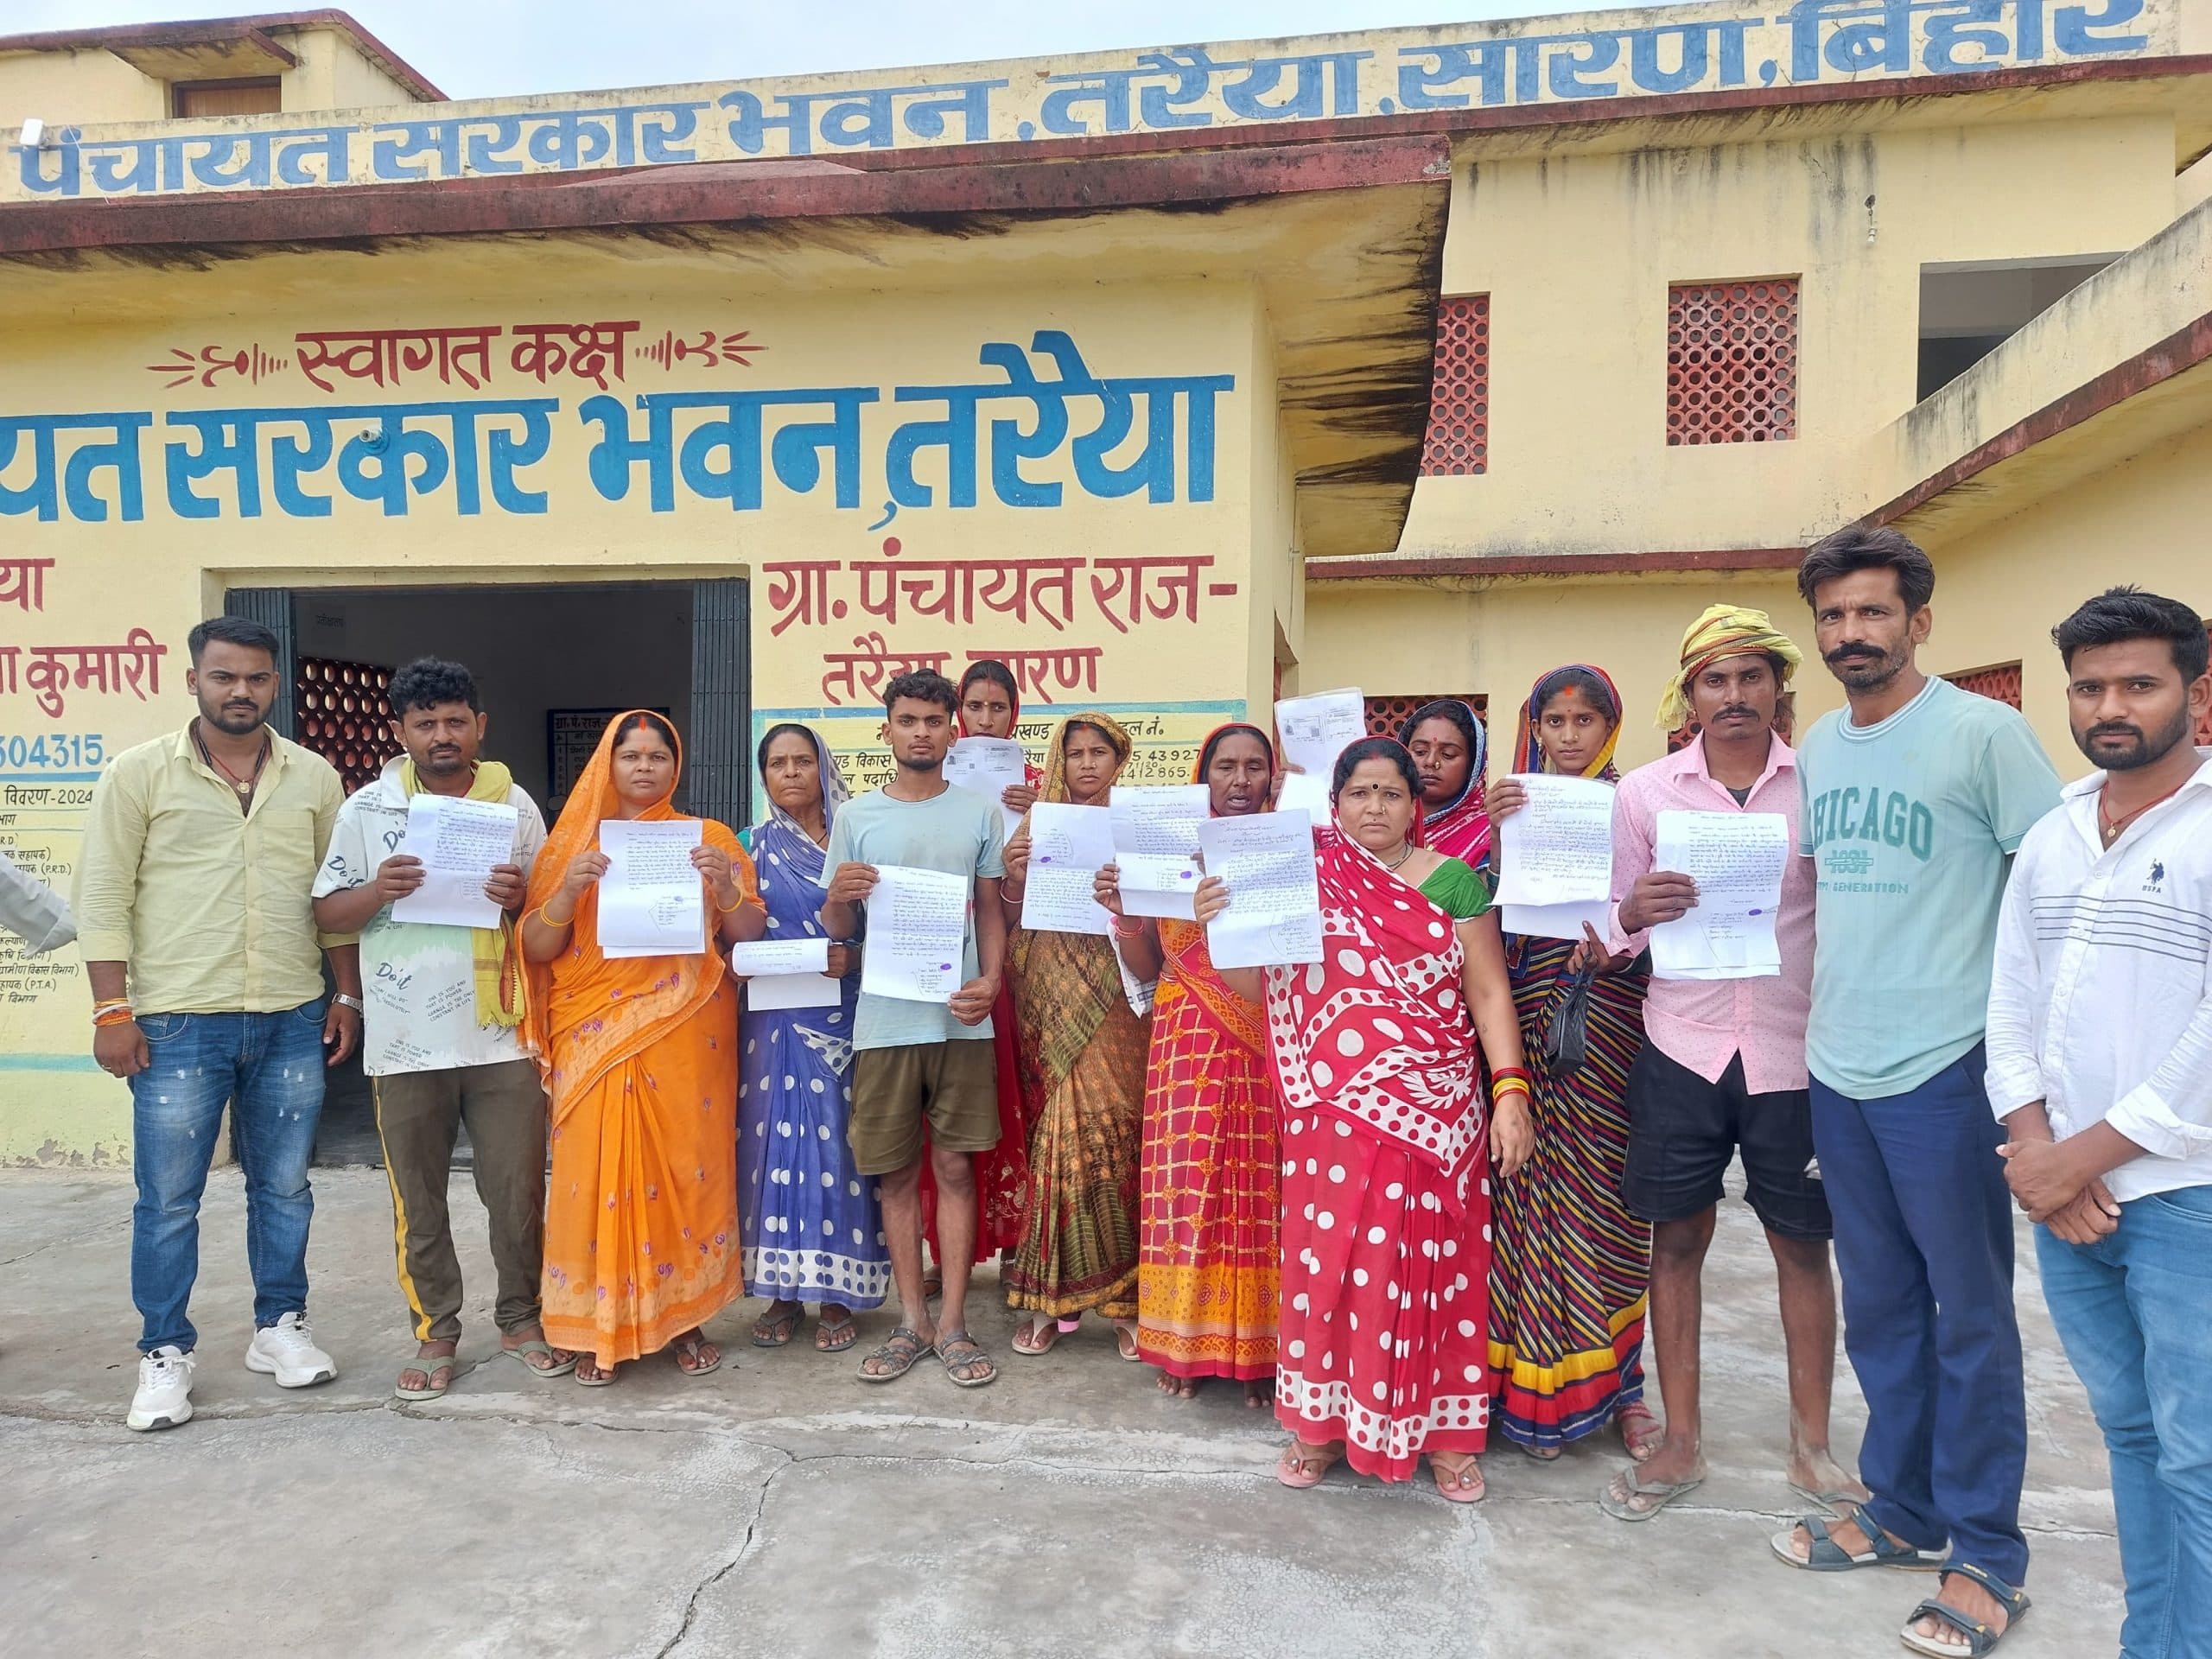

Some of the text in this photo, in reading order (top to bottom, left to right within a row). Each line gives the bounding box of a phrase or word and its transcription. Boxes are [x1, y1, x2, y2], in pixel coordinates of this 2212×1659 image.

[9, 125, 361, 195] पंचायत
[373, 101, 710, 179] सरकार
[1776, 0, 2149, 82] बिहार
[295, 321, 640, 392] स्वागत कक्ष
[166, 397, 559, 518] सरकार
[886, 330, 1235, 508] तरैया
[850, 537, 1087, 632] पंचायत
[26, 628, 168, 718] कुमारी
[966, 647, 1103, 704] ारण
[855, 752, 892, 767] विकास
[1024, 748, 1046, 764] रैया
[1814, 786, 1934, 862] HICAGO
